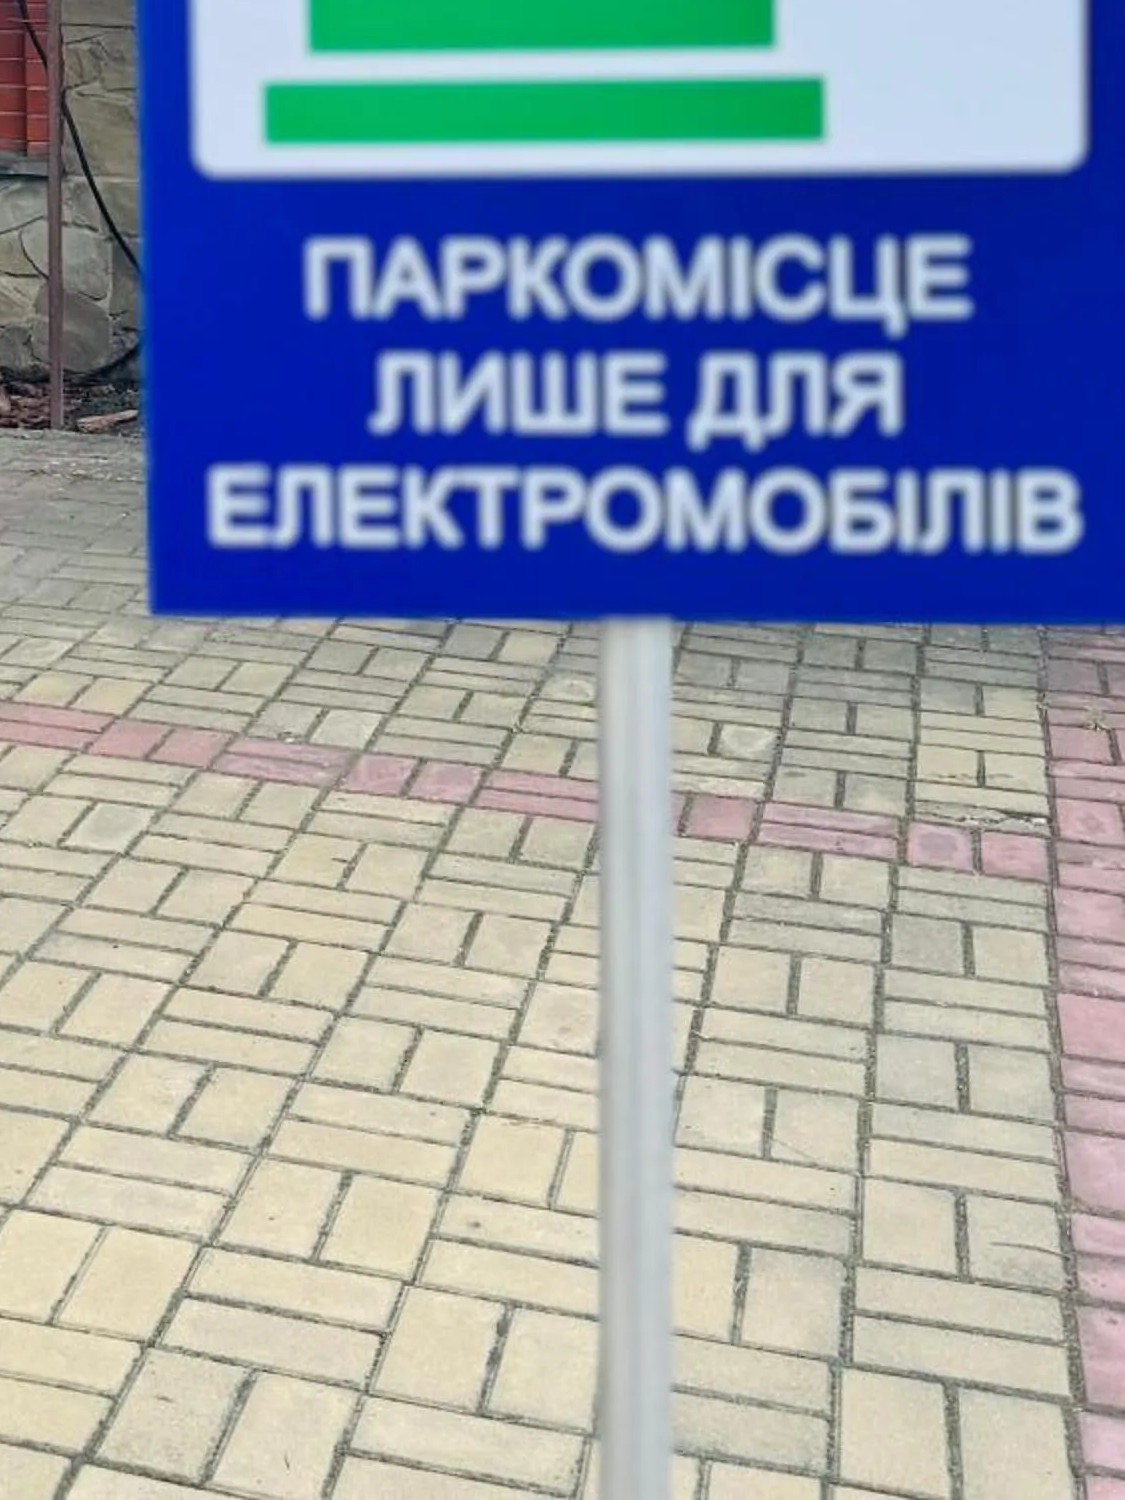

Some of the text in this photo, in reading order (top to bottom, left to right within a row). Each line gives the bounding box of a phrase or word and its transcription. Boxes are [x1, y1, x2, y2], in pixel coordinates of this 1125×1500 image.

[305, 235, 972, 336] ПАРКОМІСЦЕ
[369, 351, 903, 450] ЛИШЕ ДЛЯ
[208, 464, 1083, 554] ЕЛЕКТРОМОБІЛІВ
